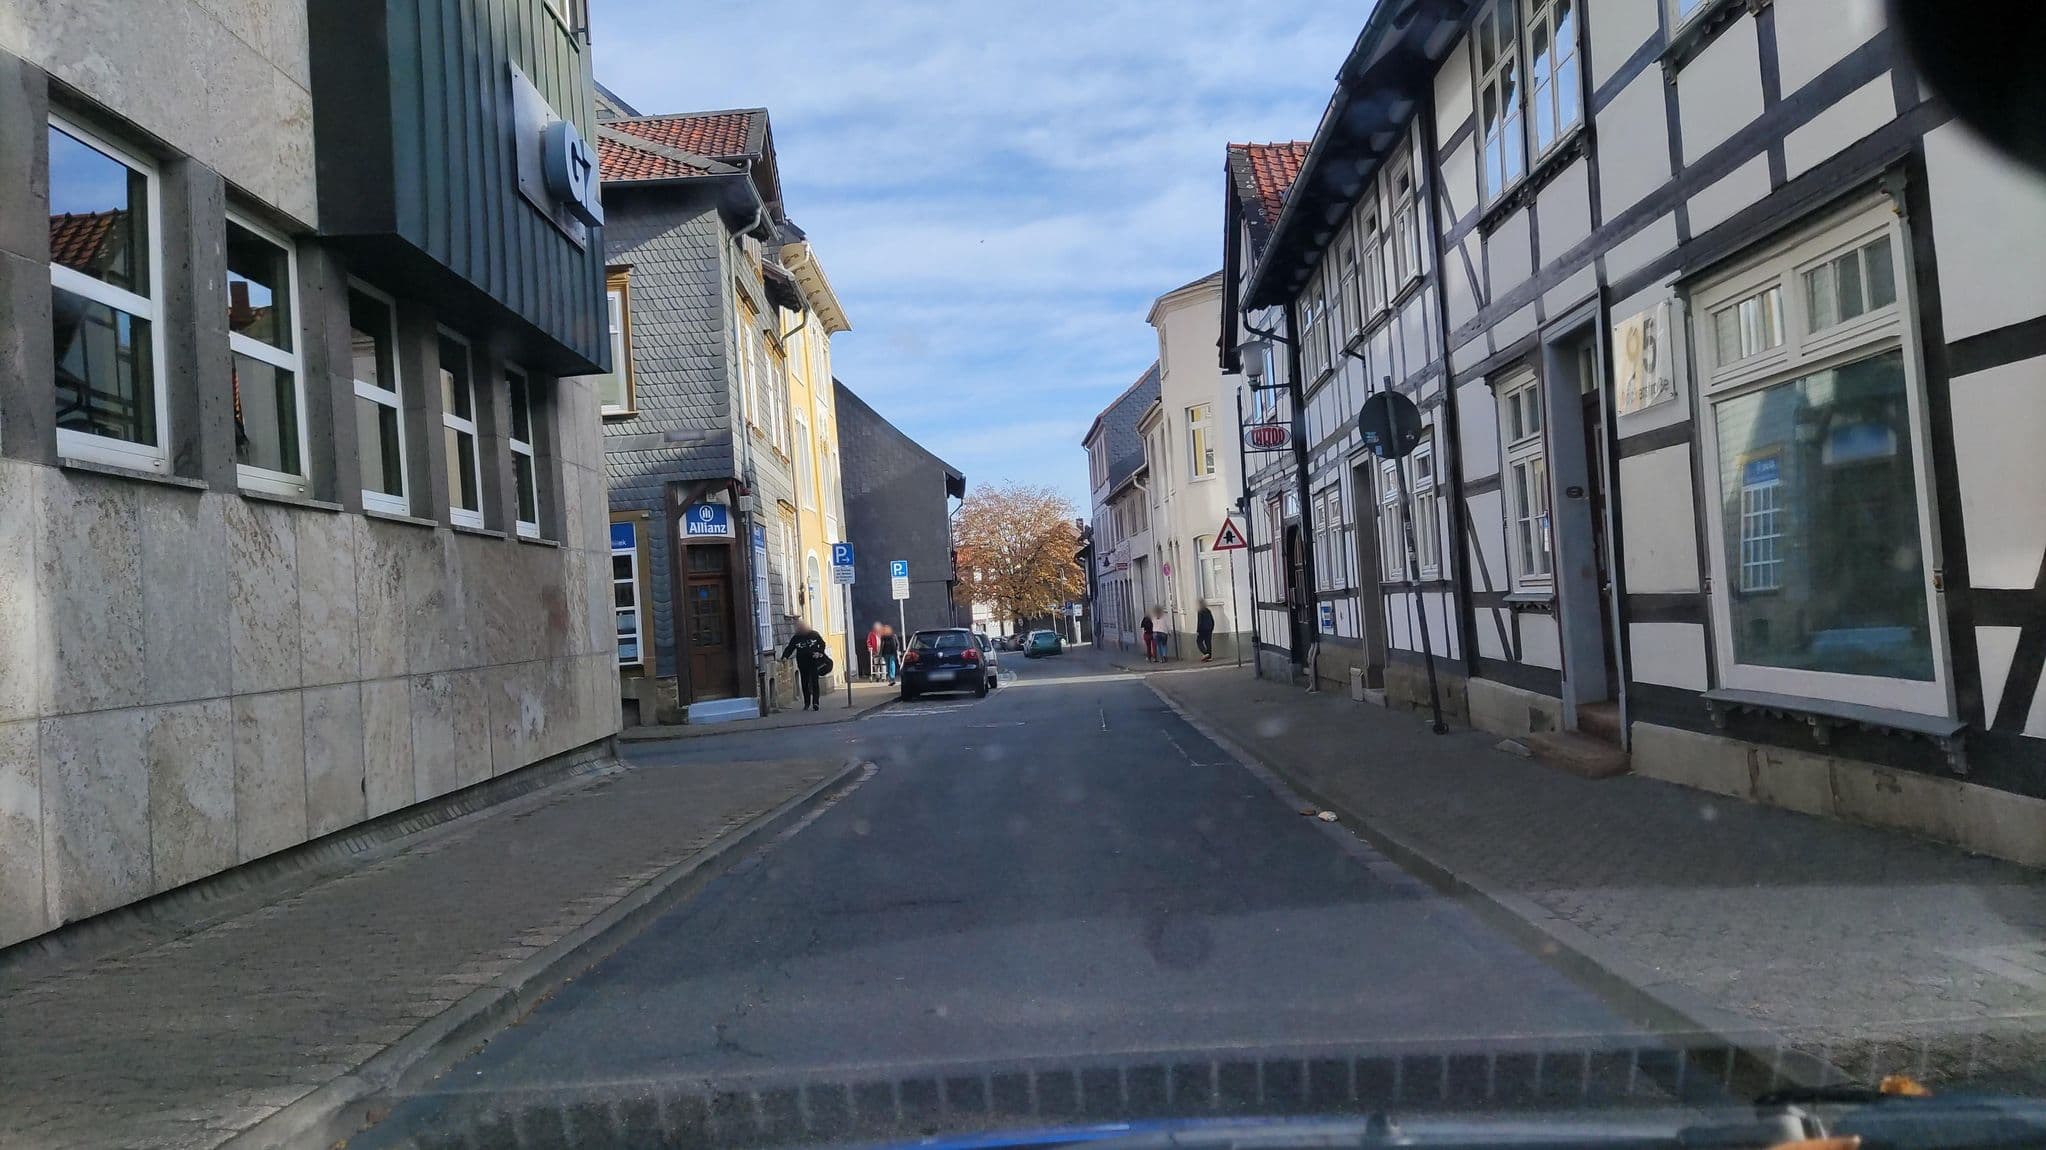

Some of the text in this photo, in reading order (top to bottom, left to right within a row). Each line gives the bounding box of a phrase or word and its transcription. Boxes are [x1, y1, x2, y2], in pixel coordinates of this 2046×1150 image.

[689, 522, 727, 534] Allianz
[836, 546, 847, 563] P
[894, 563, 902, 576] P
